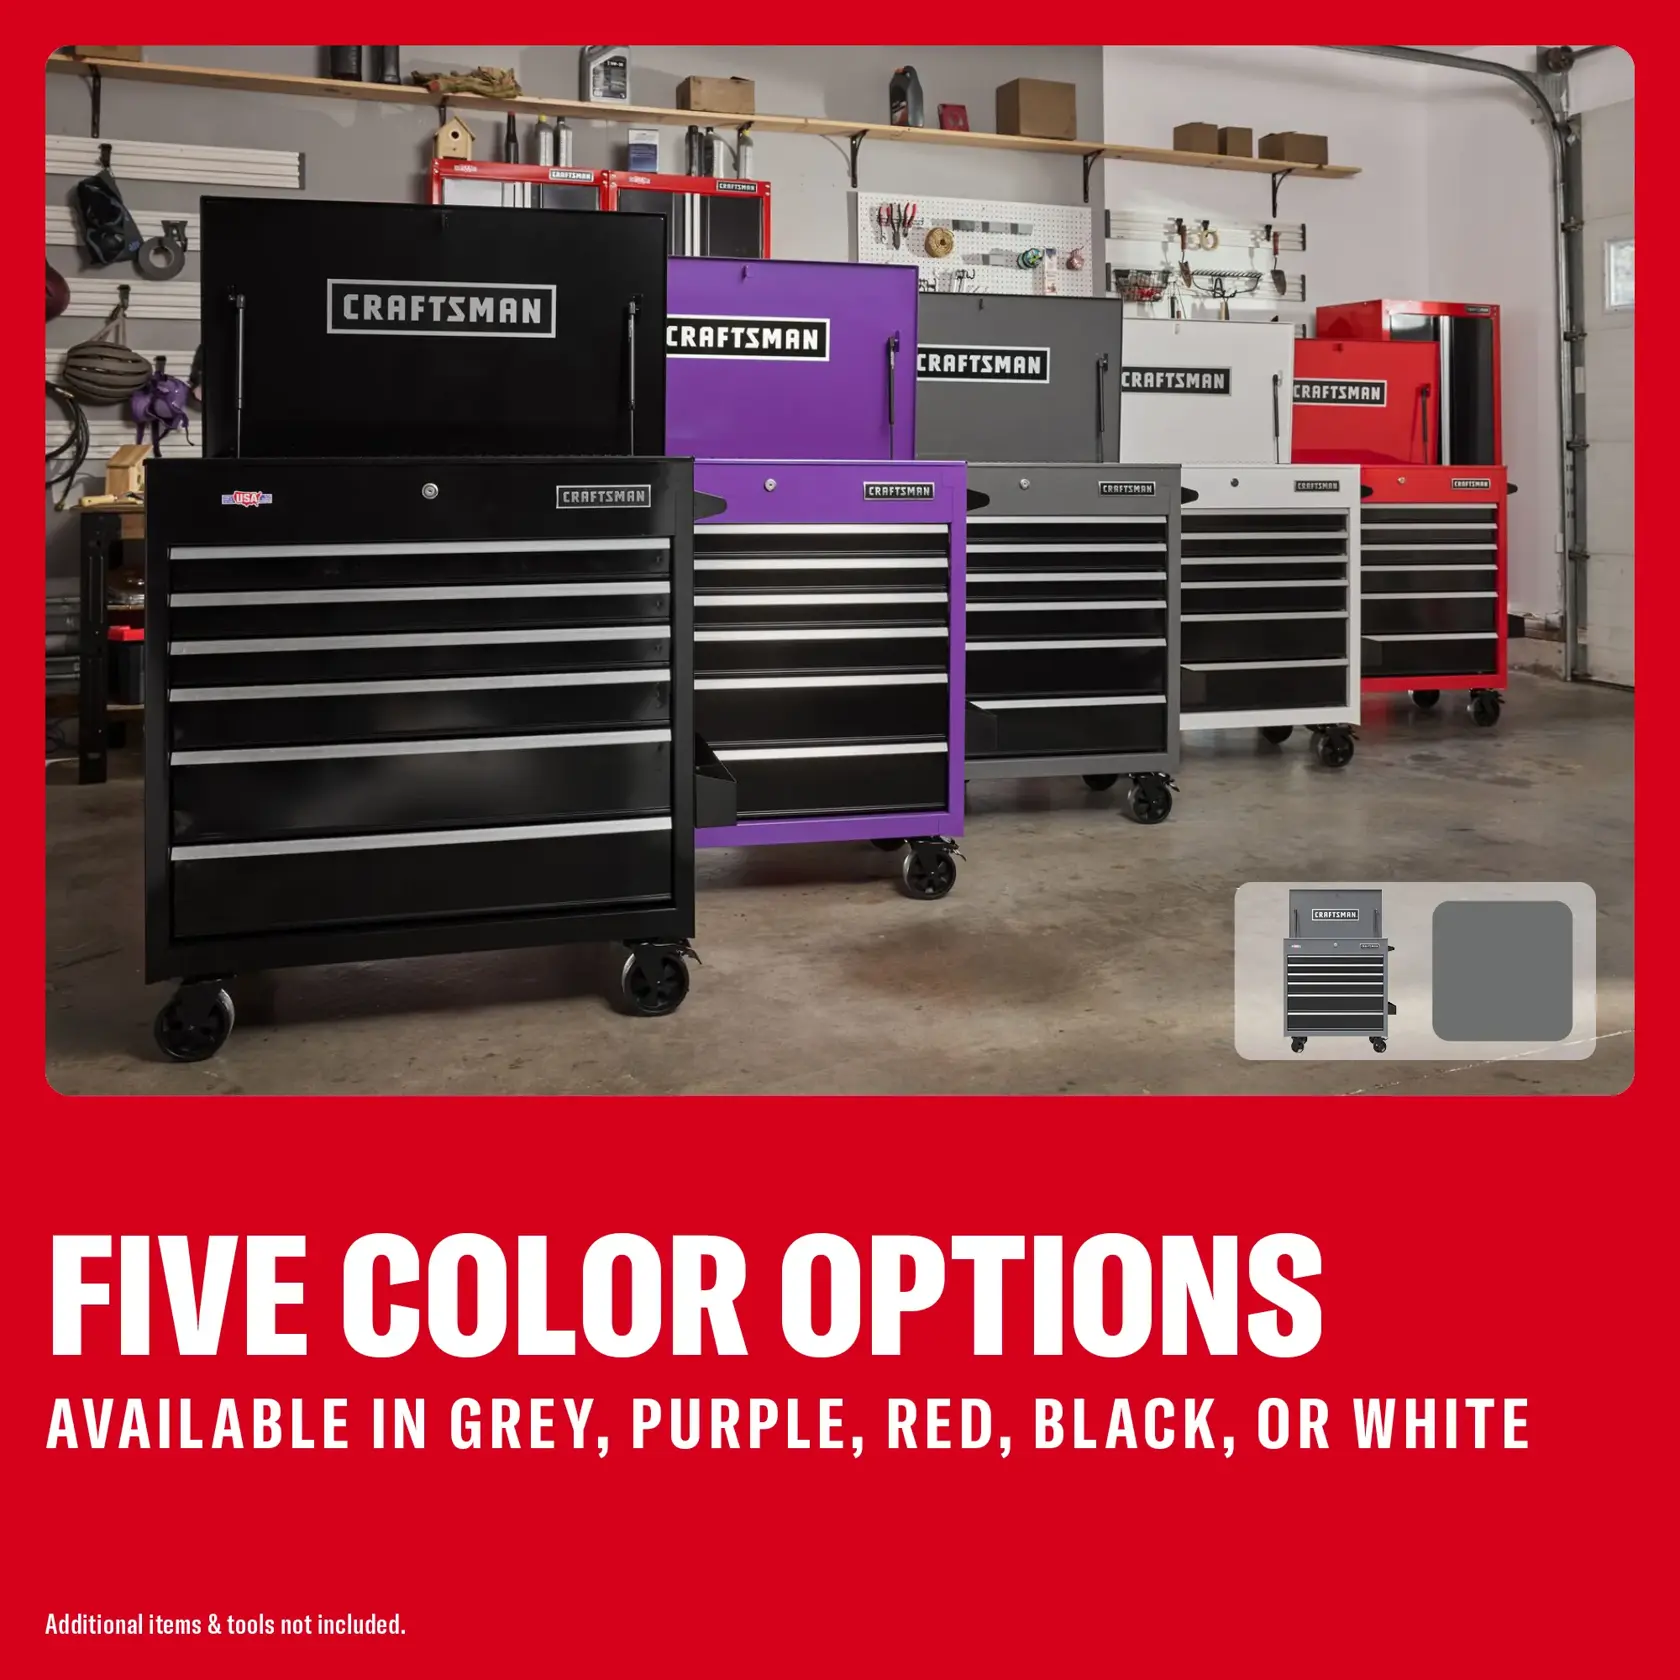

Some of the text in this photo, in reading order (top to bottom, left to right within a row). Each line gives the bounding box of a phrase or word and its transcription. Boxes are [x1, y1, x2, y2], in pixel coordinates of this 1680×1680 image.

[719, 183, 755, 191] CRAFTSMAN
[343, 293, 541, 324] CRAFTSMAN
[666, 325, 818, 351] CRAFTSMAN
[916, 353, 1041, 375] CRAFTSMAN
[1121, 371, 1225, 389] CRAFTSMAN
[1293, 384, 1381, 401] CRAFTSMAN
[868, 486, 930, 497] CRAFTSMAN
[1102, 484, 1152, 494] CRAFTSMAN
[236, 493, 258, 503] USA
[562, 490, 646, 503] CRAFTSMAN
[1314, 911, 1357, 919] CRAFTSMAN
